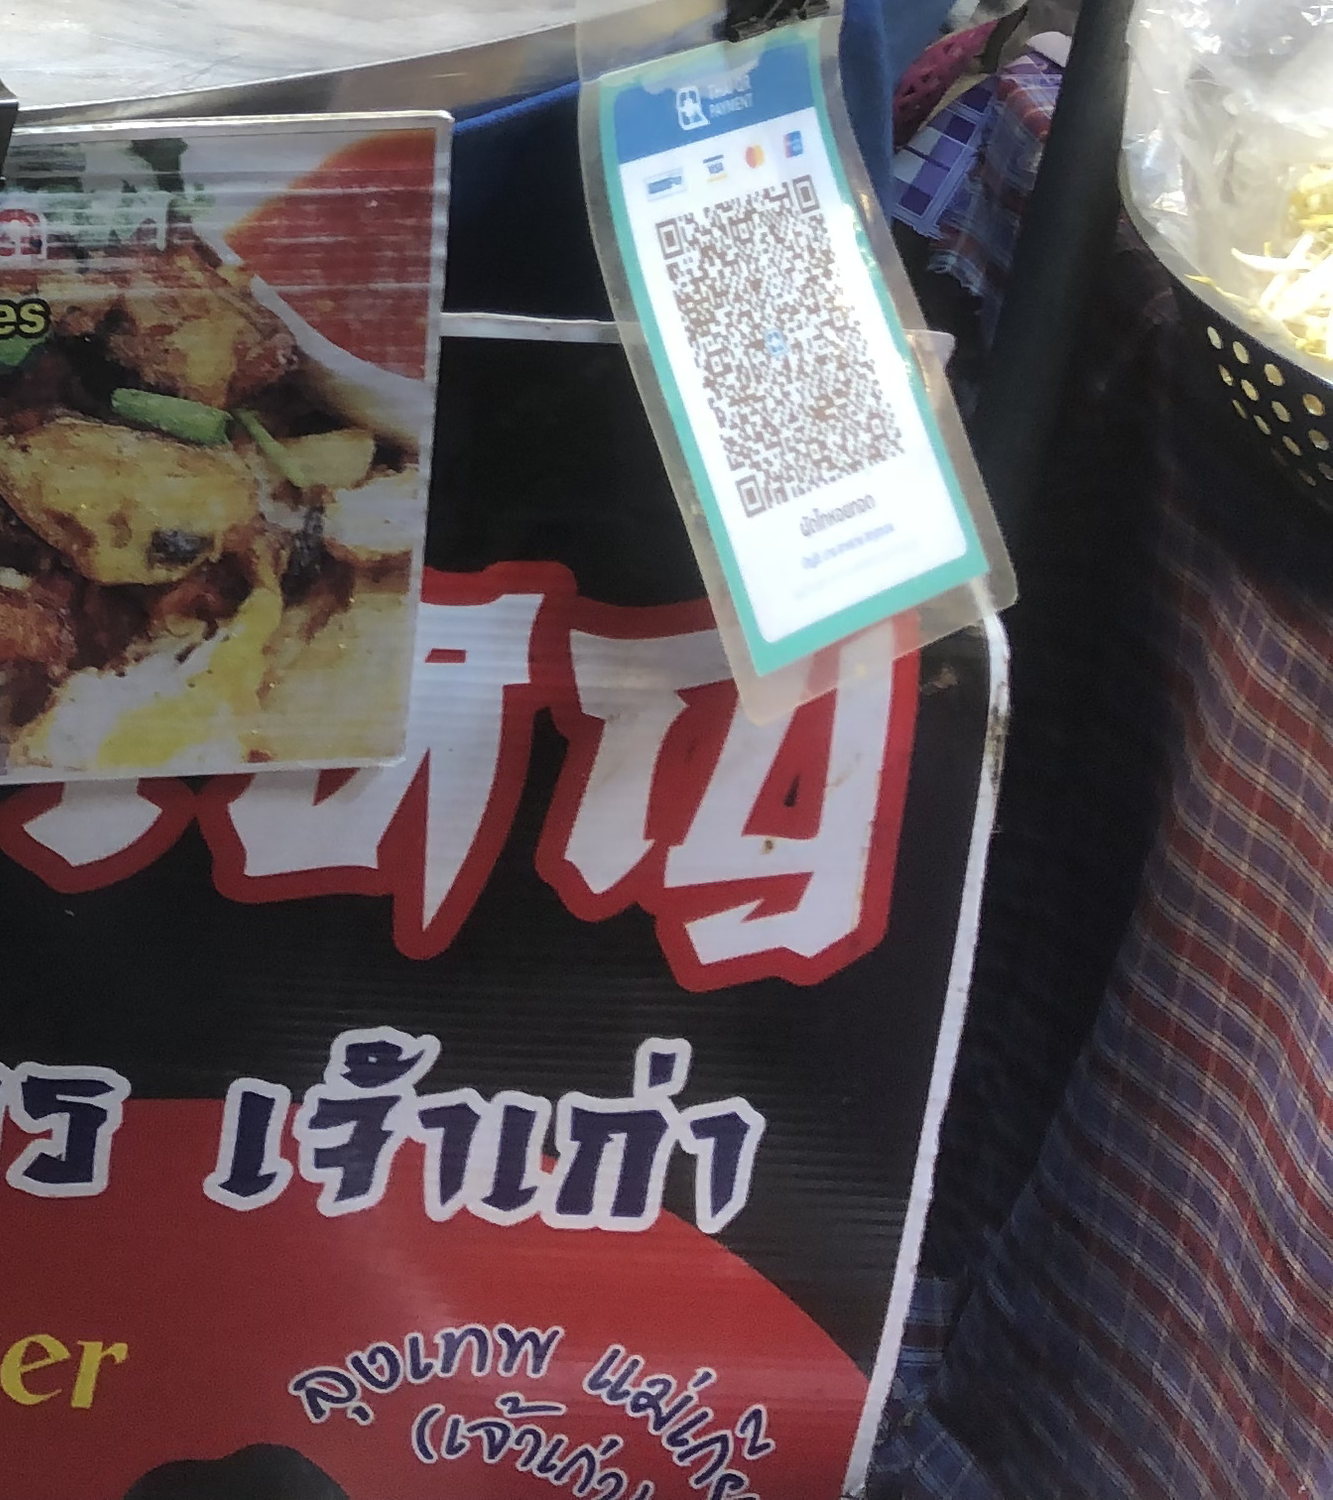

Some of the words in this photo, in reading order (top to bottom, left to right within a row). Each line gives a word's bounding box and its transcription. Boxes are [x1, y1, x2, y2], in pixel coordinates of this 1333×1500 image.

[209, 1031, 760, 1227] เจ้าเก่า
[290, 1323, 564, 1425] ลุงเทพ
